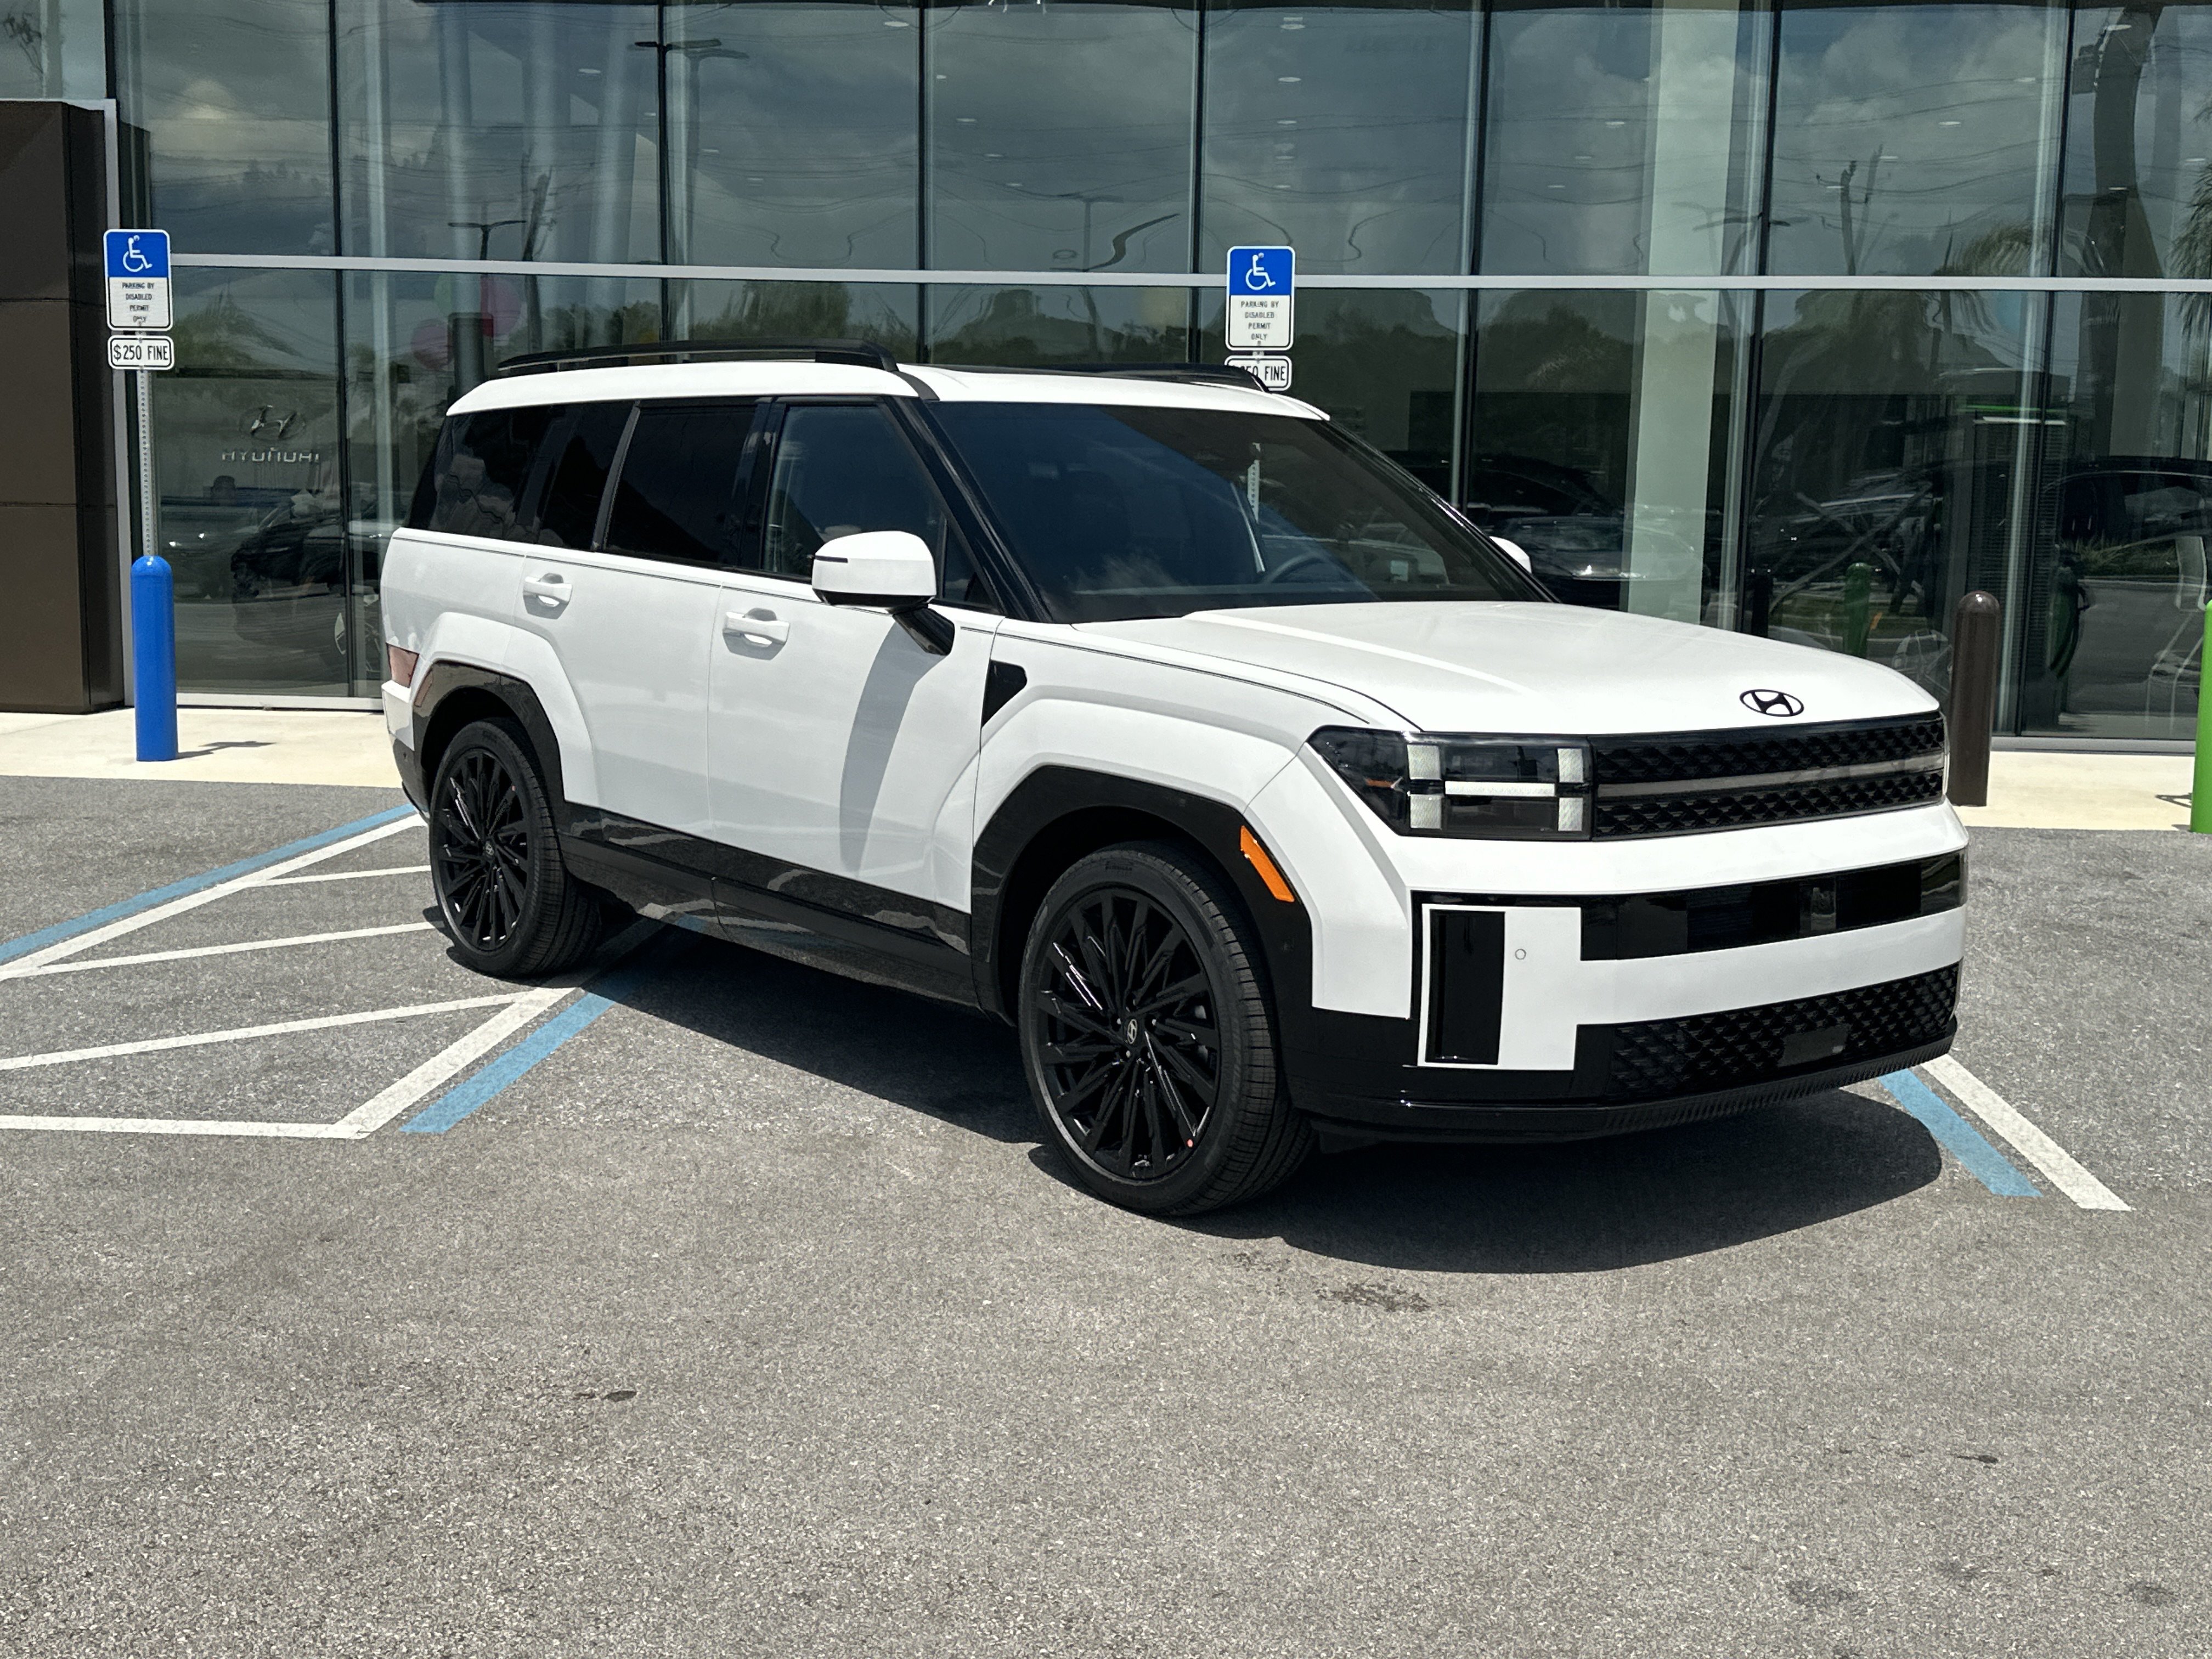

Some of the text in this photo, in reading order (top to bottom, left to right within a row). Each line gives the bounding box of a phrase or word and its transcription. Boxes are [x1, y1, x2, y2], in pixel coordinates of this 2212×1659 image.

[113, 344, 169, 362] $250 FINE
[1264, 365, 1286, 381] FINE
